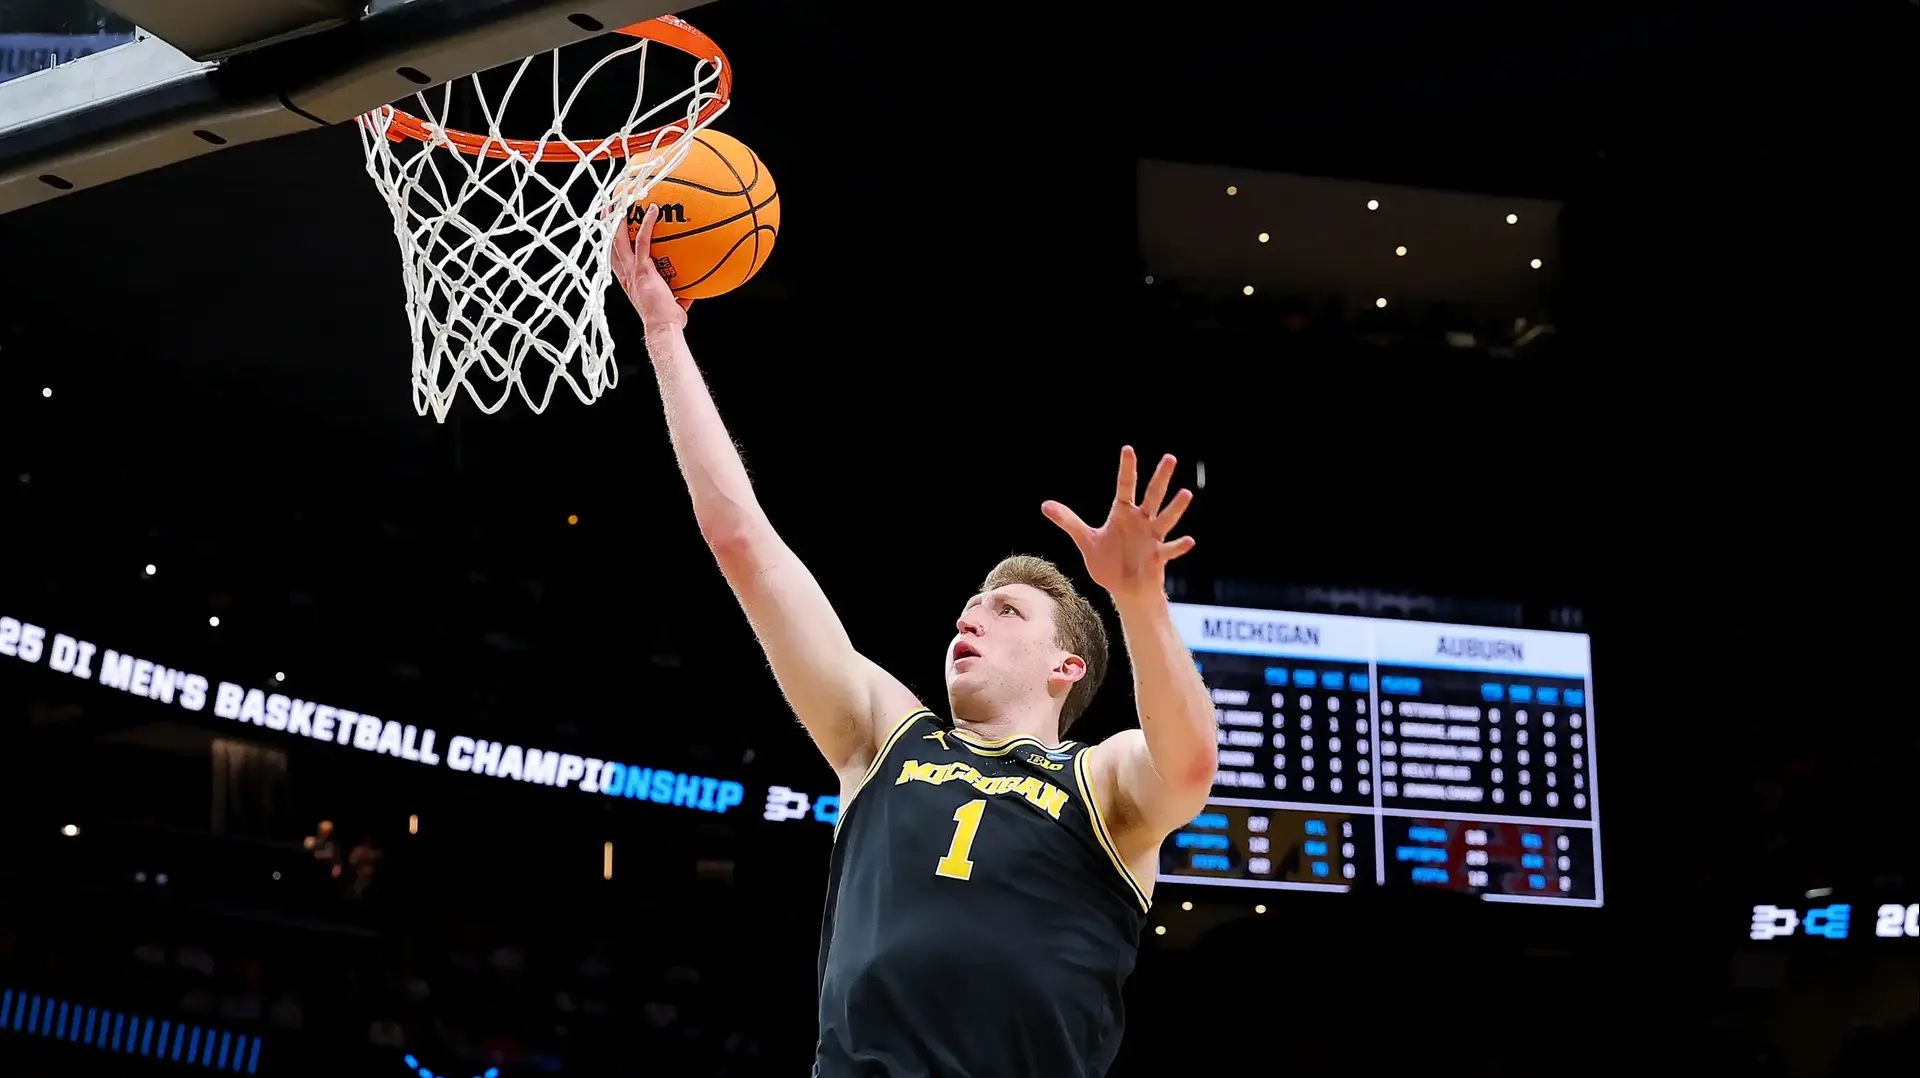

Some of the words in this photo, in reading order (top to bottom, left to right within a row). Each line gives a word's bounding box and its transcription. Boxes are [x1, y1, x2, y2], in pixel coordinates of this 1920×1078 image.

[1203, 617, 1322, 646] MICHIGAN
[1436, 634, 1525, 662] AUBURN
[49, 633, 97, 679] DI
[99, 649, 209, 711] MEN'S
[214, 681, 441, 766] BASKETBALL
[446, 734, 745, 813] CHAMPIONSHIP
[895, 759, 1070, 820] MICHIGAN
[935, 798, 987, 881] 1
